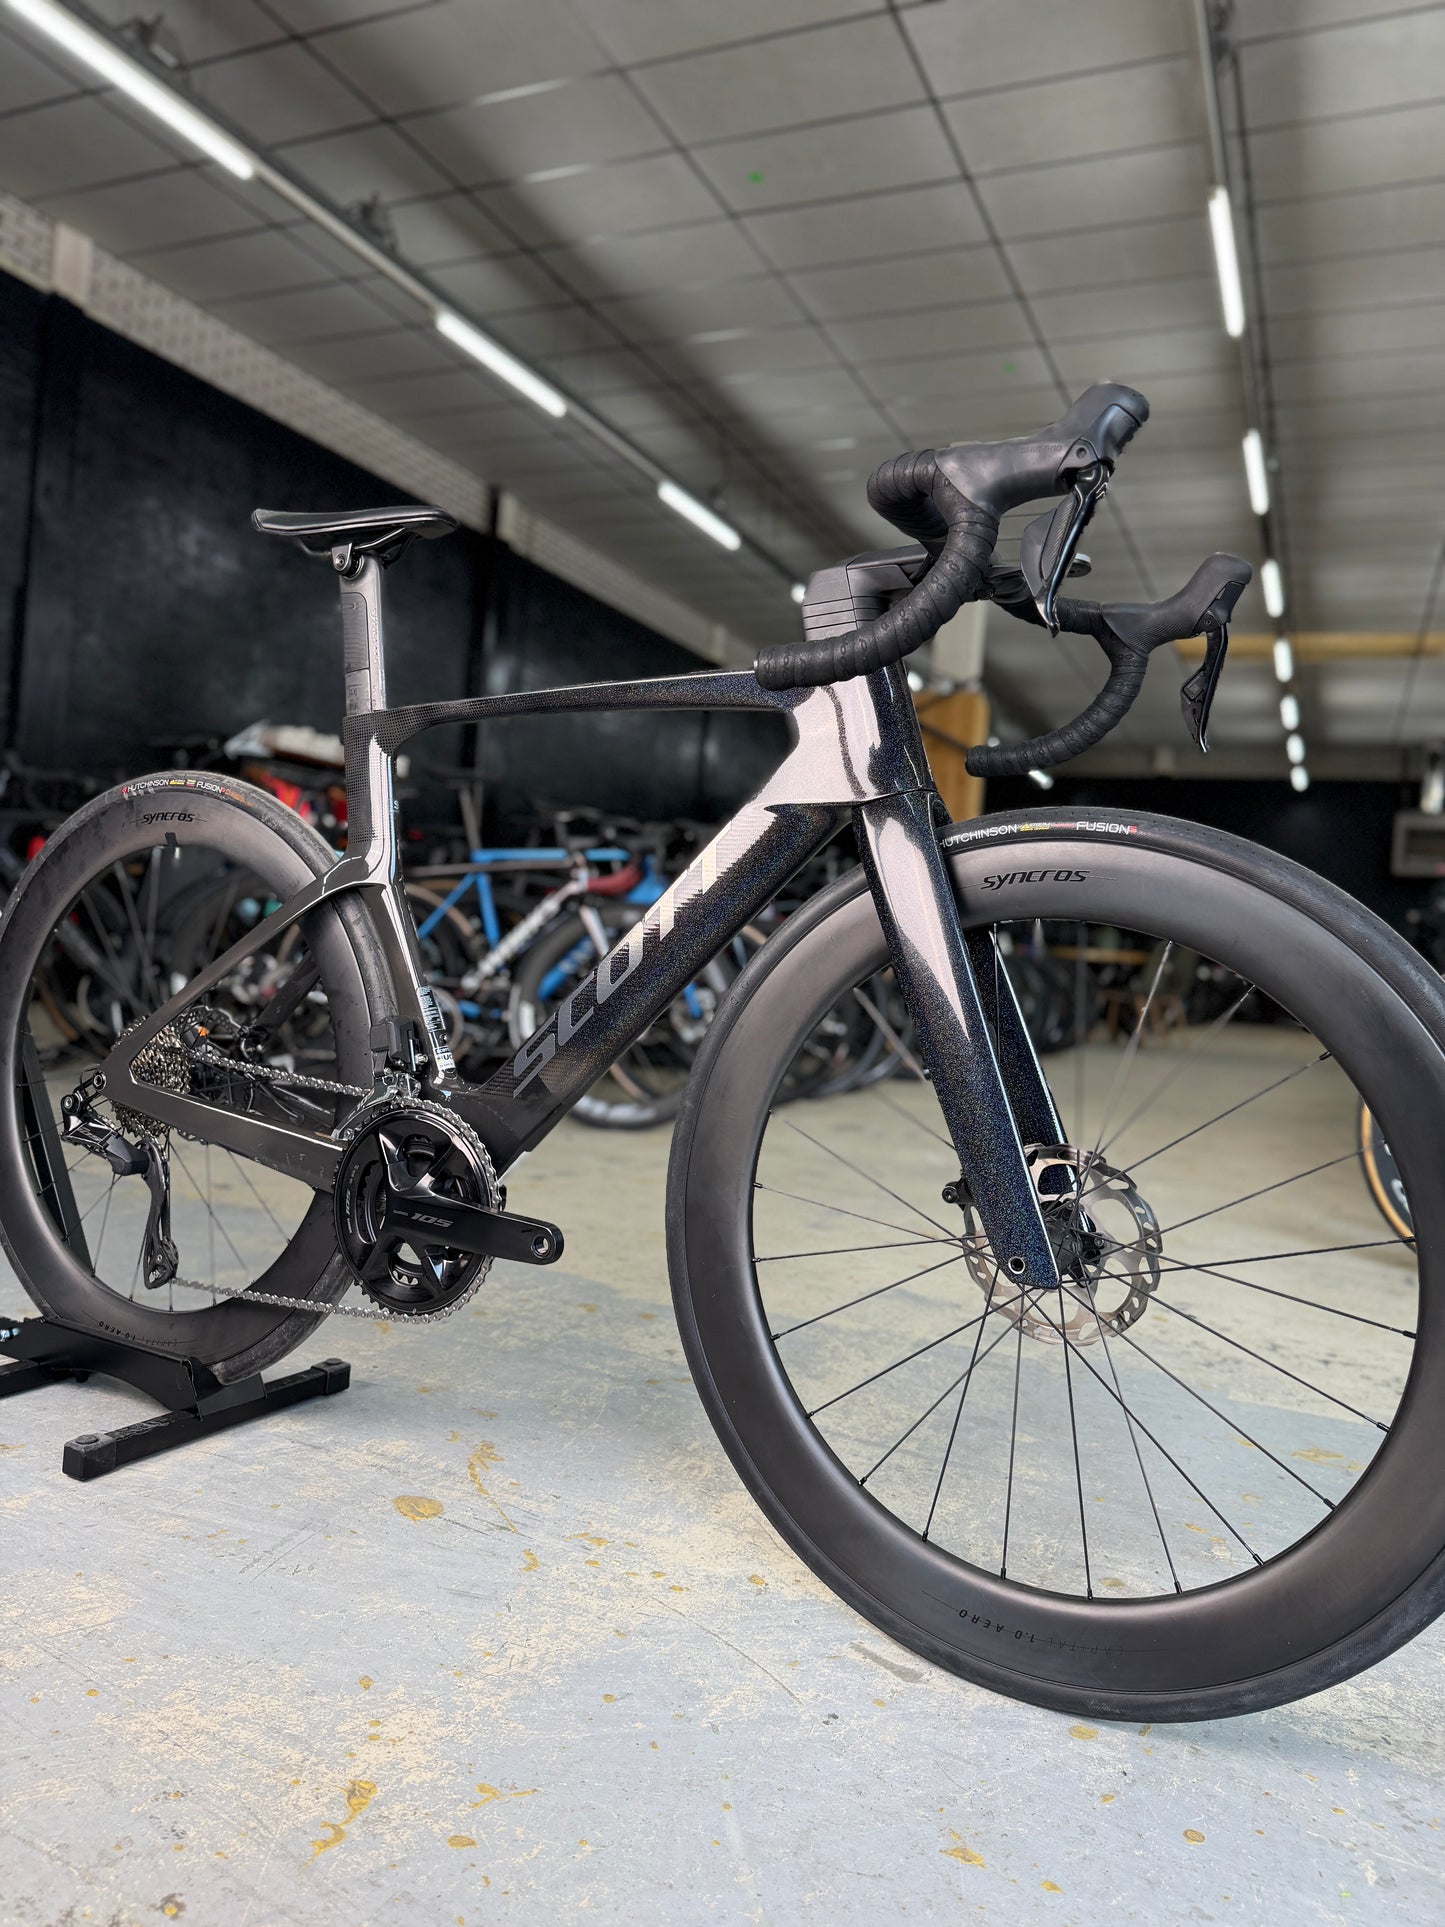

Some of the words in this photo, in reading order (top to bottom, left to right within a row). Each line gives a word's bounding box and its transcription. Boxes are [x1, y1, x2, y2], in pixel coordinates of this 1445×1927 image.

[127, 779, 169, 792] HUTCHINSON
[513, 820, 732, 1099] SCOTT
[411, 1212, 454, 1228] 105
[98, 1320, 121, 1335] AERO
[958, 1609, 1005, 1633] AERO
[1014, 1630, 1035, 1643] 1.0
